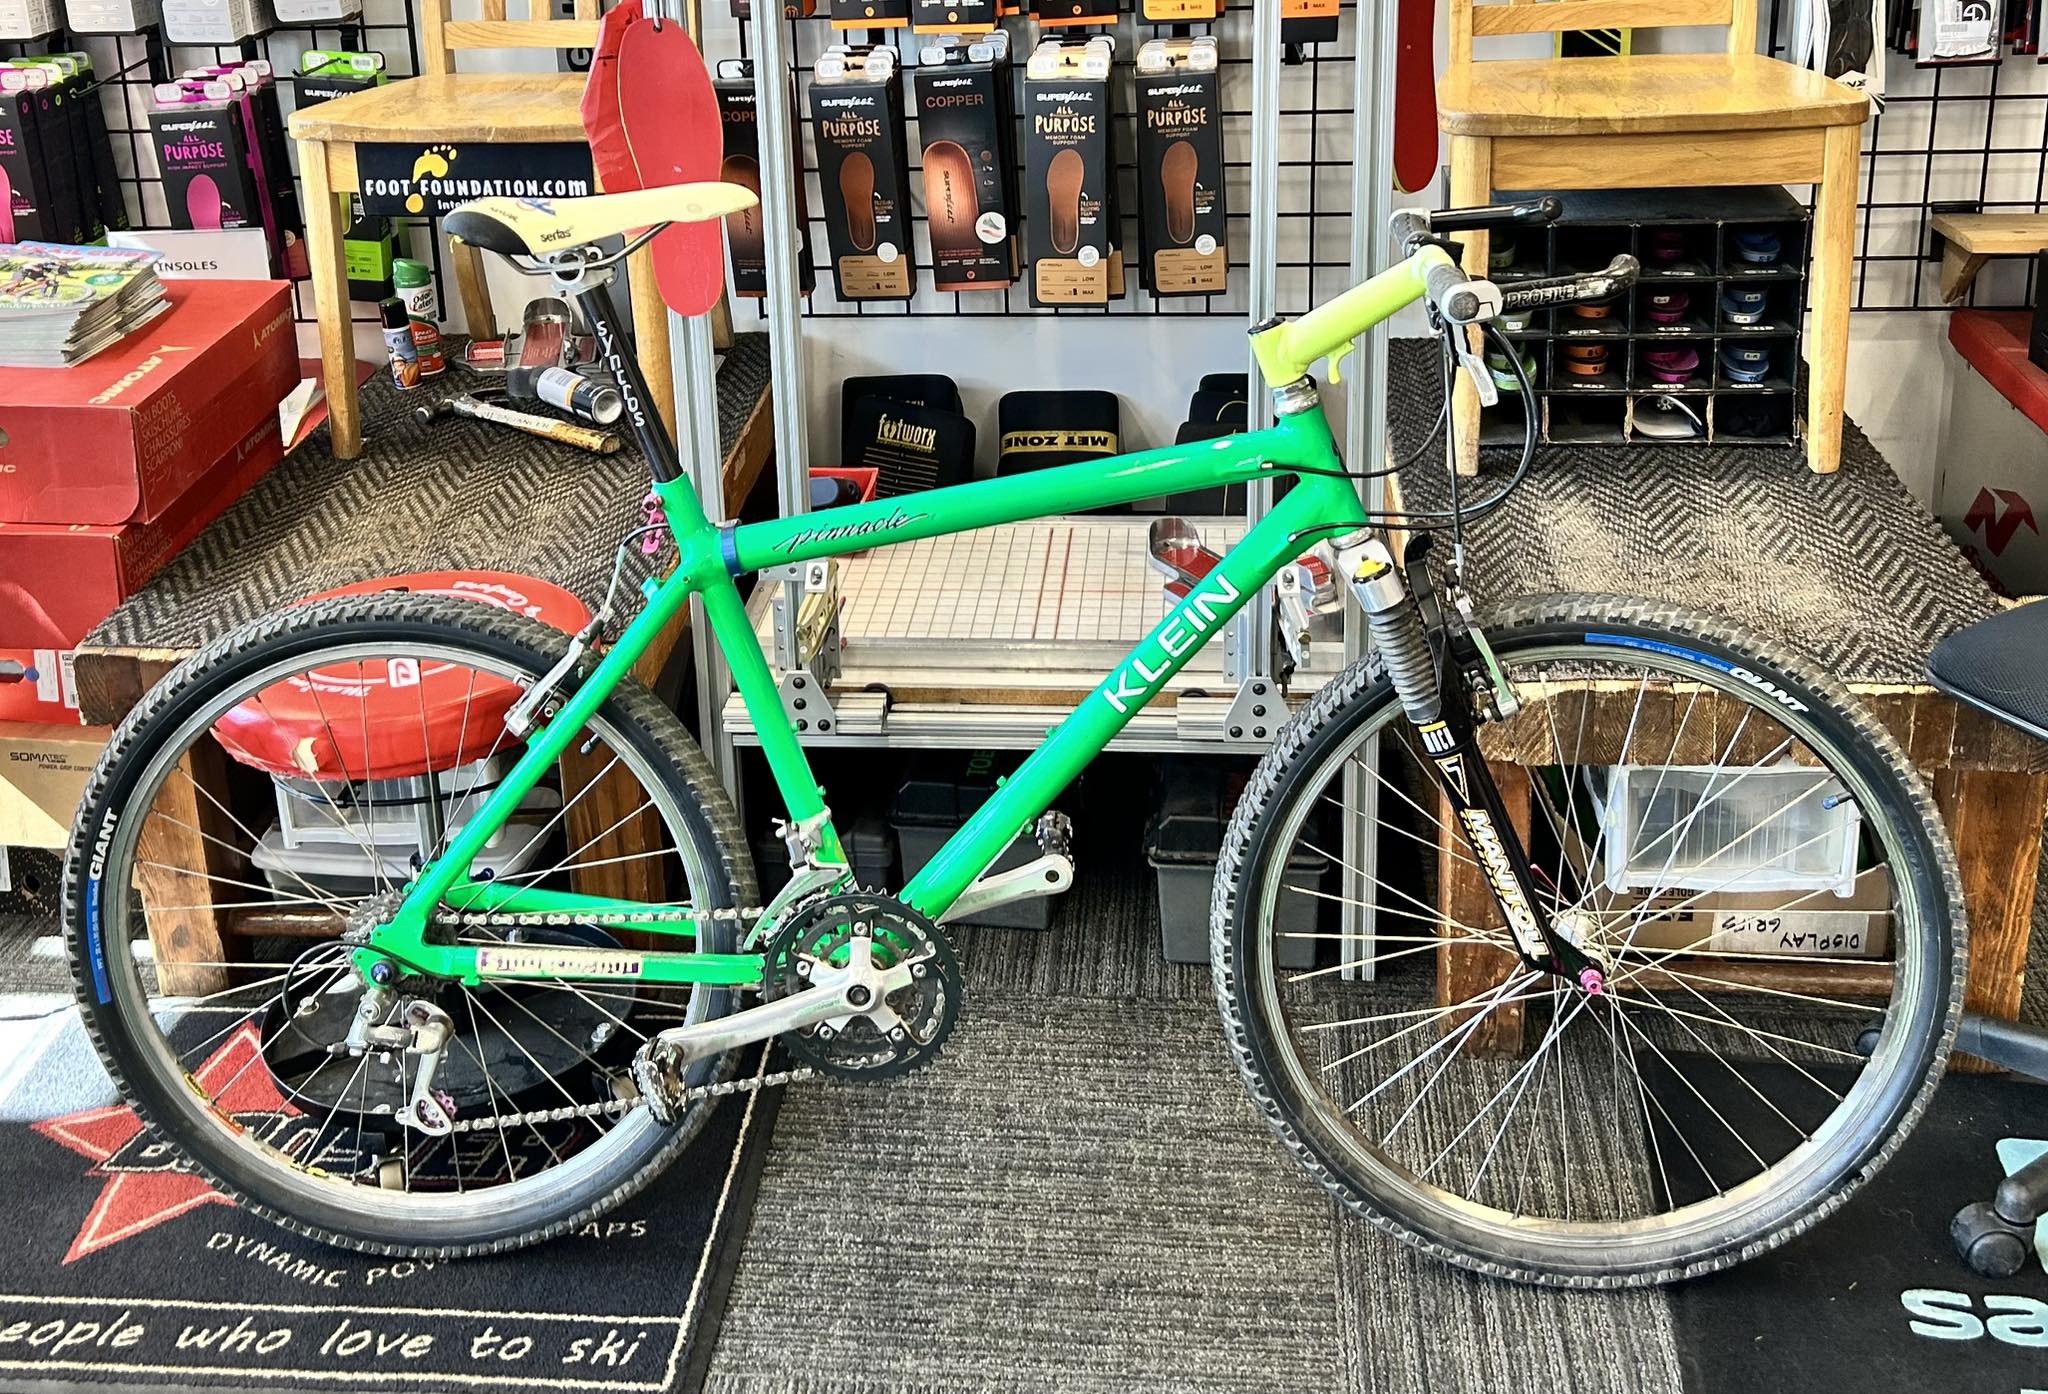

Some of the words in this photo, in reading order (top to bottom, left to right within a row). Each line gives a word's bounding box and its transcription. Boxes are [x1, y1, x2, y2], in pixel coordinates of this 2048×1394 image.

[925, 94, 984, 109] COPPER
[1057, 105, 1073, 115] ALL
[1168, 99, 1184, 108] ALL
[841, 111, 858, 119] ALL
[1035, 114, 1096, 134] PURPOSE
[1147, 107, 1208, 128] PURPOSE
[822, 119, 881, 139] PURPOSE
[163, 142, 225, 162] PURPOSE
[365, 179, 411, 196] FOOT
[260, 307, 292, 342] ATOMIC
[88, 356, 163, 405] ATOMIC
[152, 390, 177, 418] BOOTS
[244, 418, 277, 453] ATOMIC
[1004, 436, 1058, 448] ZONE
[1065, 436, 1109, 446] MET
[1103, 573, 1240, 714] KLEIN
[1728, 667, 1809, 713] GIANT
[89, 807, 118, 881] GIANT
[1464, 808, 1550, 962] MANITOU
[1780, 931, 1860, 951] DISPLAY
[206, 1231, 349, 1288] DYNAMIC
[176, 1316, 291, 1352] who
[320, 1320, 433, 1358] love
[471, 1325, 533, 1361] to
[563, 1330, 648, 1367] ski
